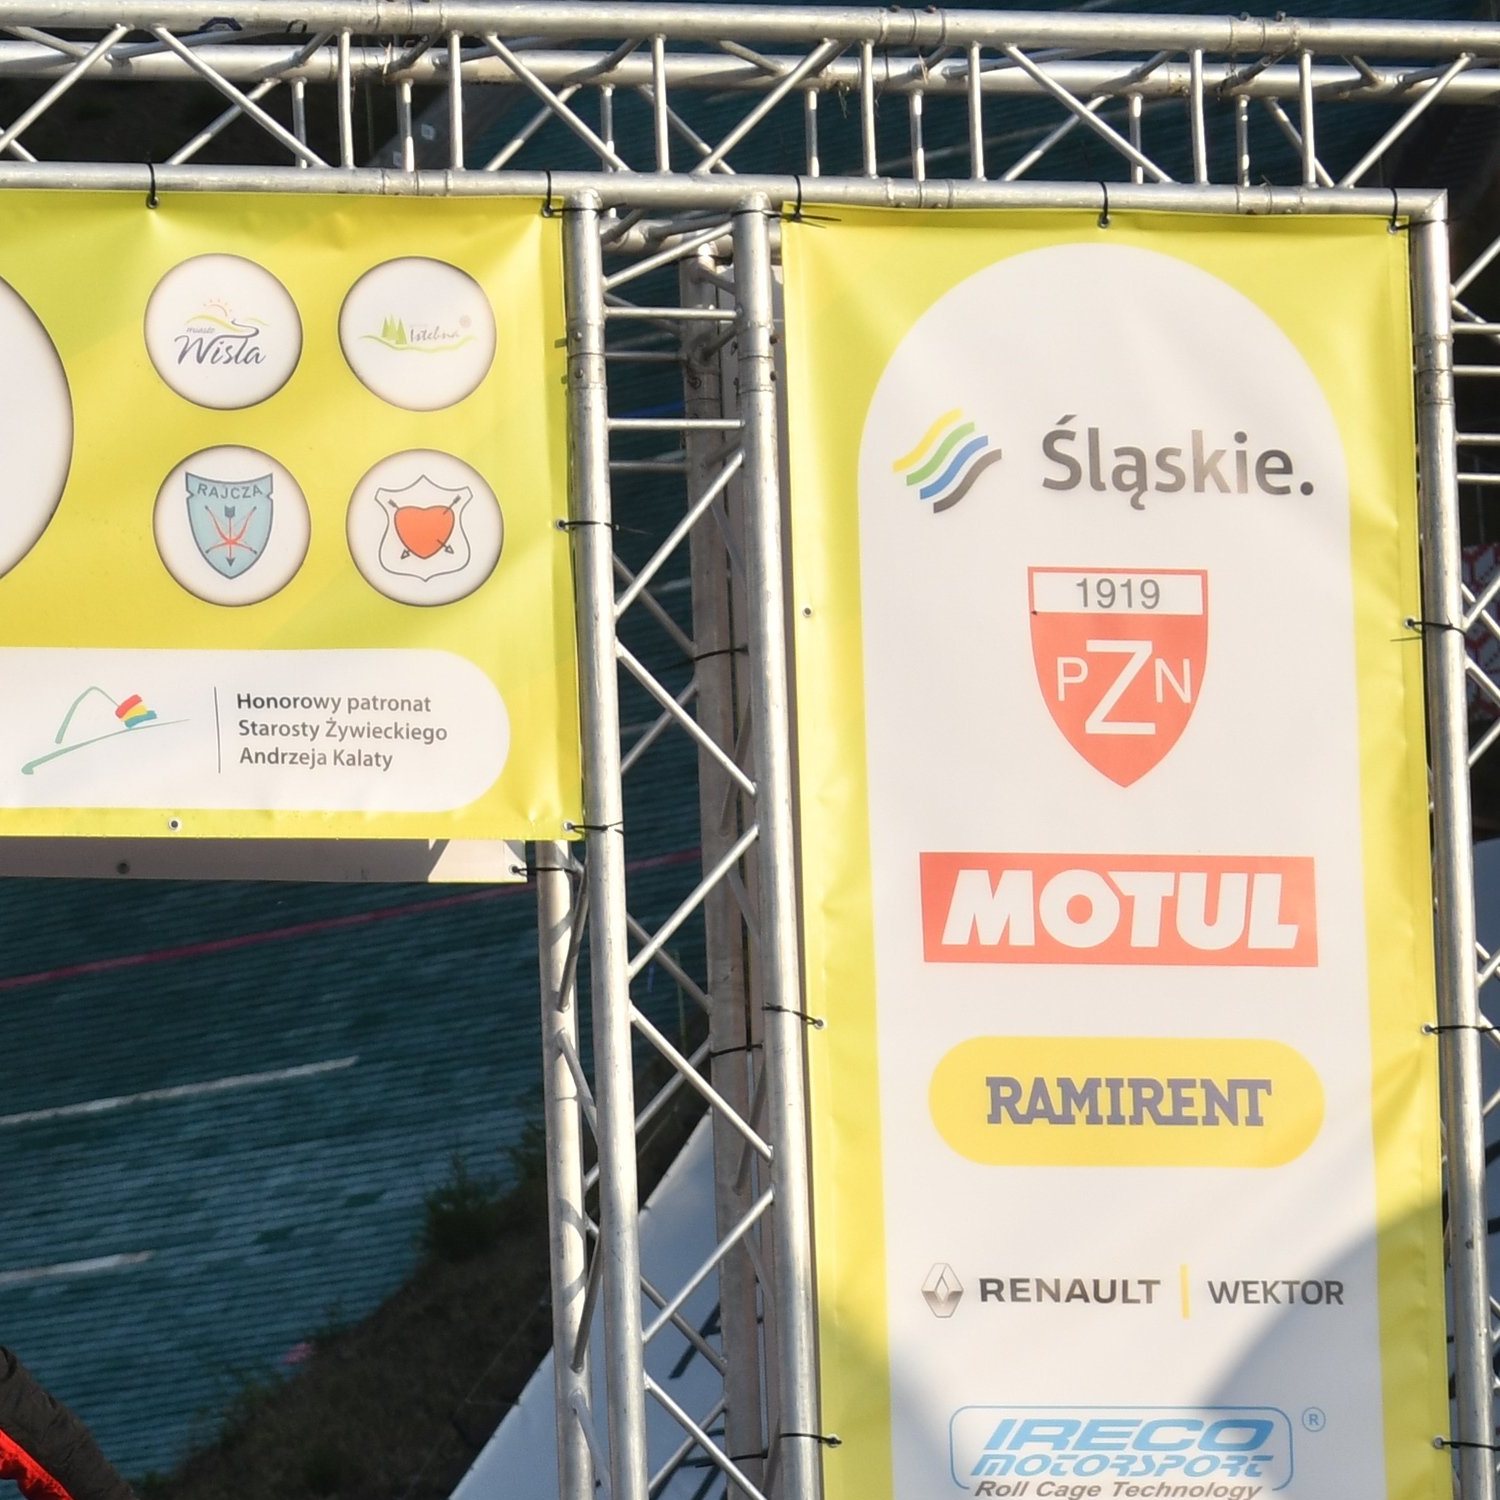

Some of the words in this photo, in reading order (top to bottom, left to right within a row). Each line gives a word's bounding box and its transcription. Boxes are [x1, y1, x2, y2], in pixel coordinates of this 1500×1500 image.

[409, 326, 461, 344] Istebna
[1041, 413, 1315, 511] Śląskie.
[197, 482, 264, 500] RAJCZA
[1074, 578, 1160, 610] 1919
[1056, 639, 1192, 735] PZN
[236, 692, 342, 713] Honorowy
[347, 695, 432, 715] patronat
[238, 719, 320, 741] Starosty
[325, 716, 448, 744] Żywieckiego
[239, 747, 328, 768] Andrzeja
[332, 748, 394, 771] Kalaty
[941, 868, 1300, 951] MOTUL
[985, 1076, 1272, 1127] RAMIRENT
[979, 1277, 1161, 1306] RENAULT
[1207, 1278, 1345, 1306] WEKTOR
[984, 1418, 1275, 1452] IRECO
[970, 1453, 1274, 1478] MOTORSPORT
[974, 1480, 1028, 1498] Roll
[1035, 1480, 1101, 1500] Cage
